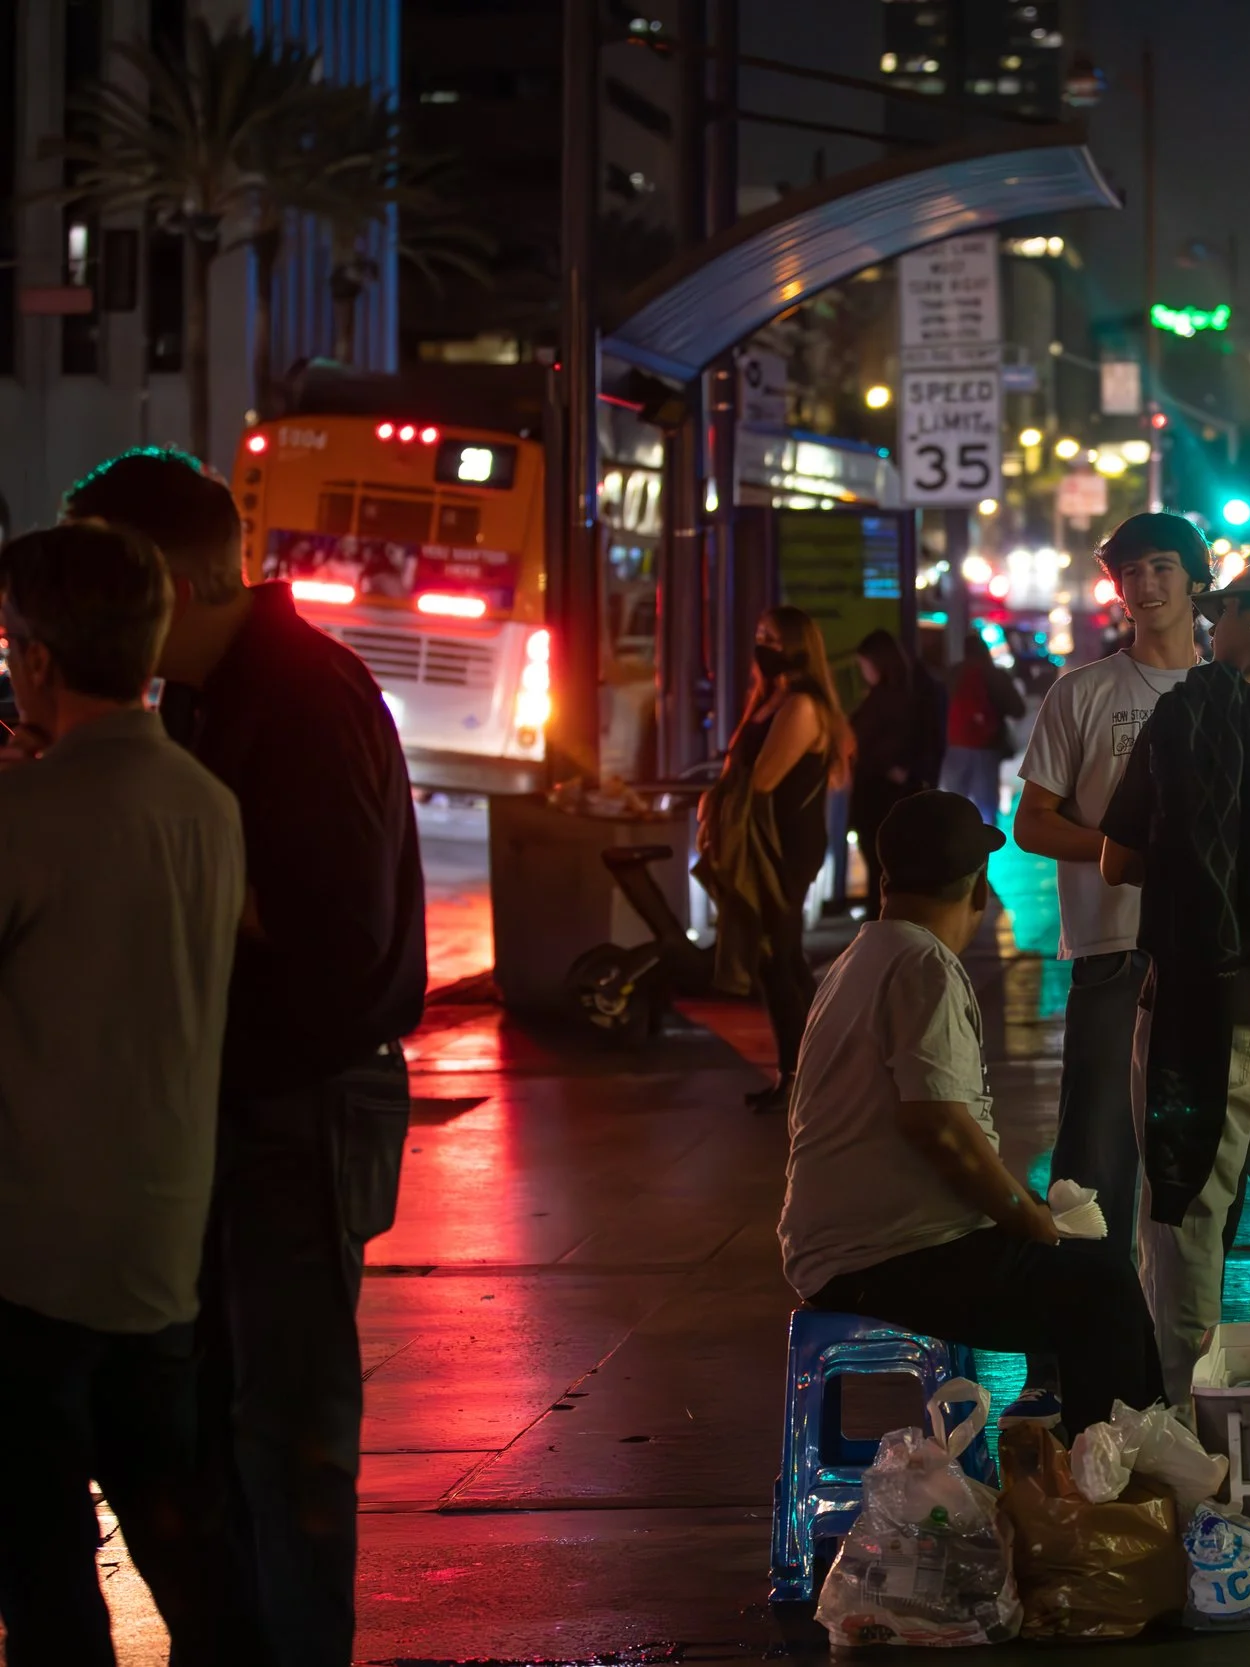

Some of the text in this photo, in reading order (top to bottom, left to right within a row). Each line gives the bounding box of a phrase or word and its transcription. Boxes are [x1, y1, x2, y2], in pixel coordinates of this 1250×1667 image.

[909, 381, 993, 404] SPEED
[918, 411, 984, 435] LIMIT
[914, 443, 992, 492] 35
[1111, 710, 1128, 724] HOW
